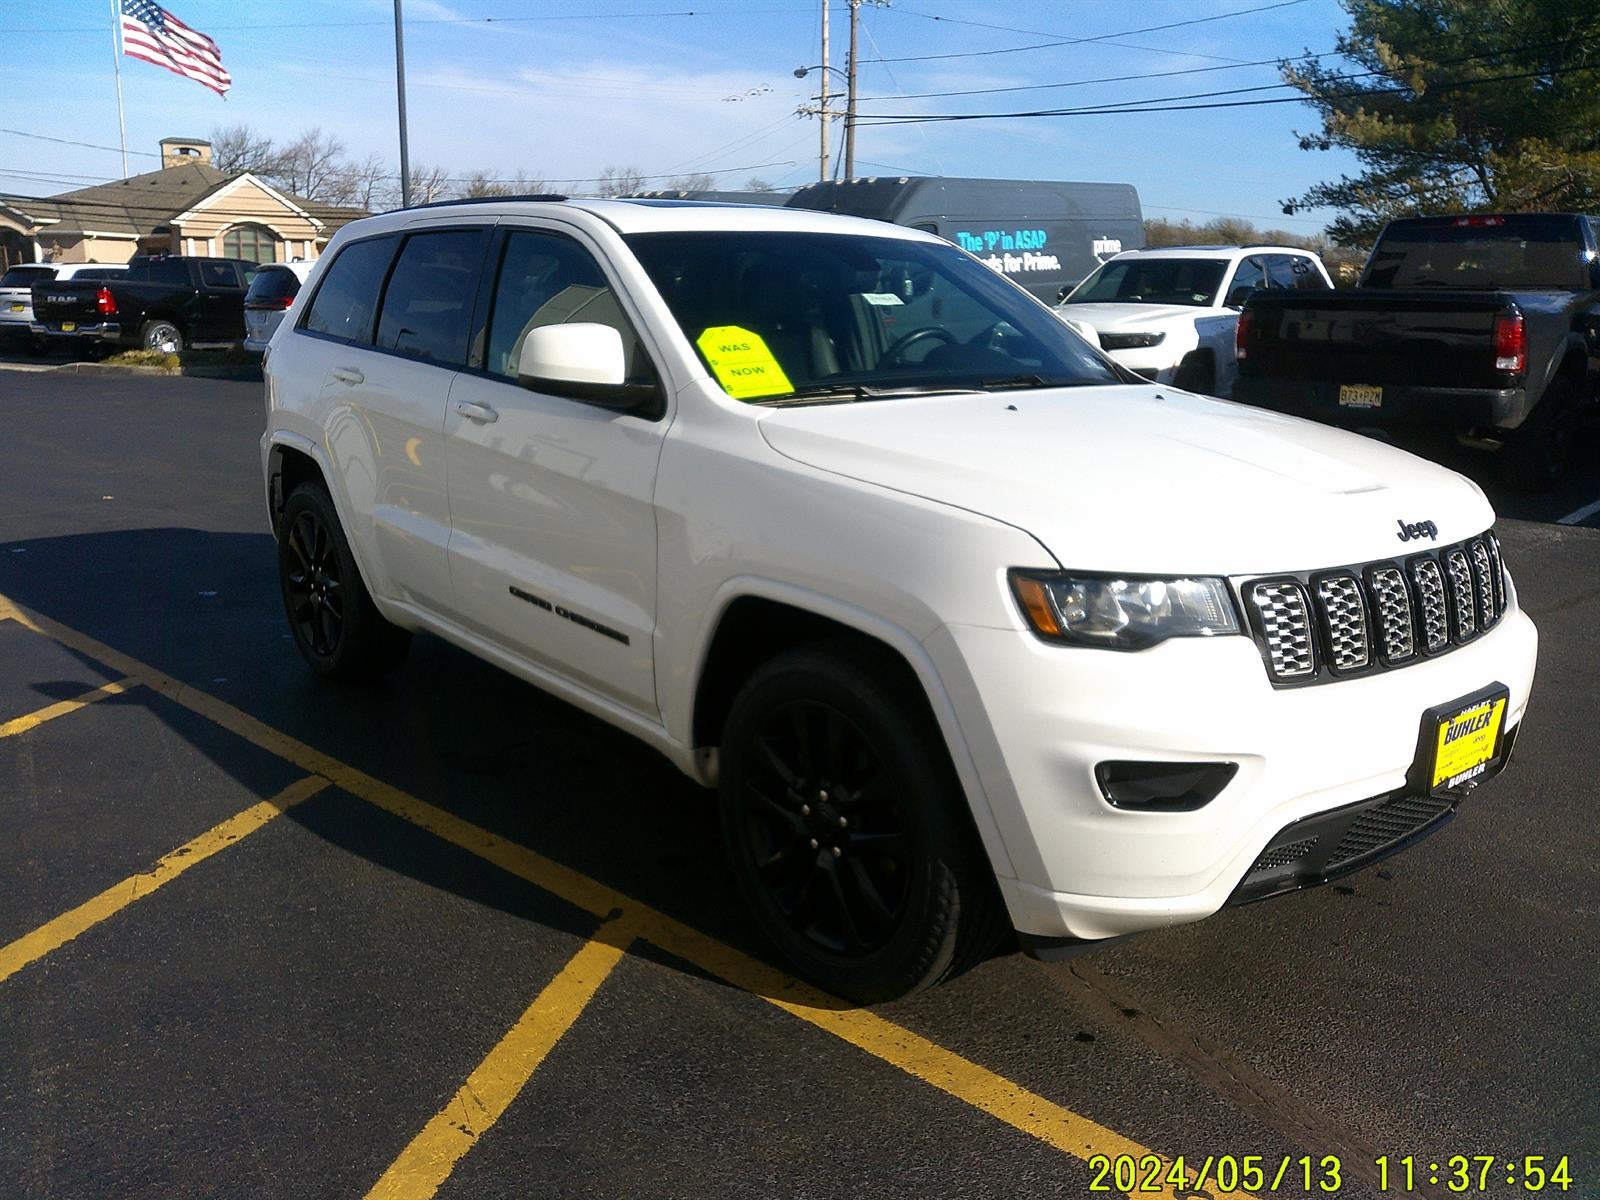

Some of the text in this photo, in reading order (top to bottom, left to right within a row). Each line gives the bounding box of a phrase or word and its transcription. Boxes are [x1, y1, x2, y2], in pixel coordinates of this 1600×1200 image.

[957, 232, 983, 251] The
[1001, 230, 1014, 249] in
[1015, 230, 1047, 248] ASAP
[1093, 236, 1121, 257] prime
[1003, 253, 1023, 272] for
[1023, 252, 1061, 271] Prime.
[47, 295, 77, 303] RAM
[719, 343, 751, 352] WAS
[730, 366, 765, 376] NOW
[1397, 519, 1438, 542] Jeep
[1443, 710, 1494, 746] BUHLER
[1447, 762, 1486, 789] BUHLER
